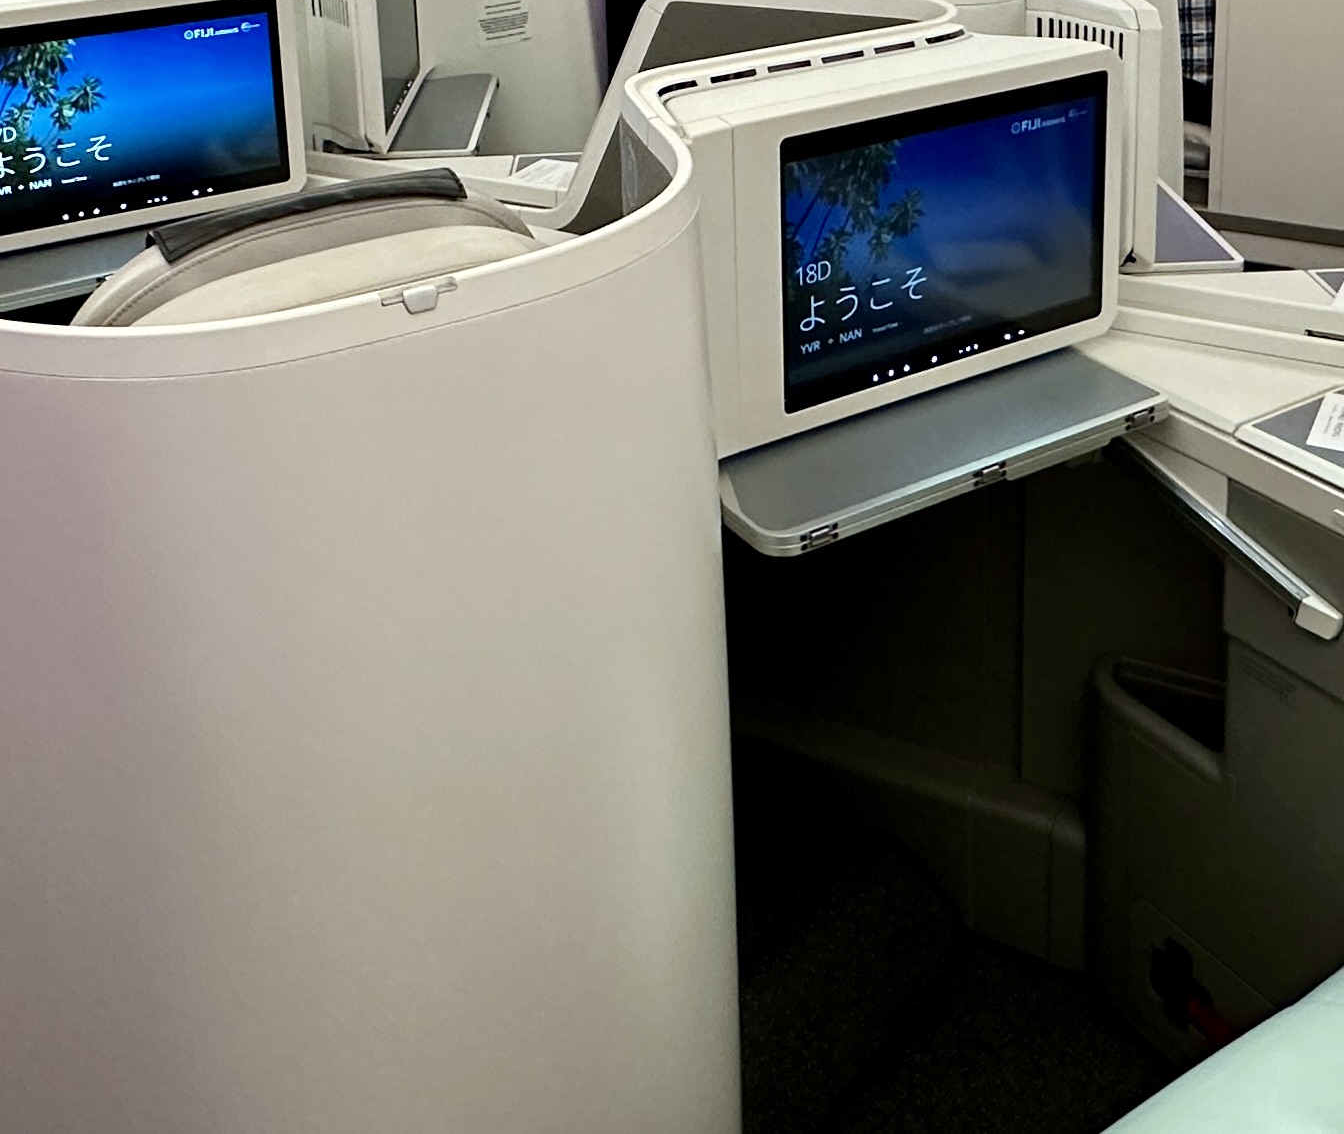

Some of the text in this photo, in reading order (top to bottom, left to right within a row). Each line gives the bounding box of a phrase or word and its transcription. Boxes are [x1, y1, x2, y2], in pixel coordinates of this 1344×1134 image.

[193, 27, 214, 39] FIJI
[1021, 117, 1042, 133] FIJI
[28, 178, 53, 191] NAN
[796, 260, 832, 287] 18D
[799, 267, 928, 332] ようこそ
[800, 340, 821, 356] YVR
[838, 328, 863, 344] NAN
